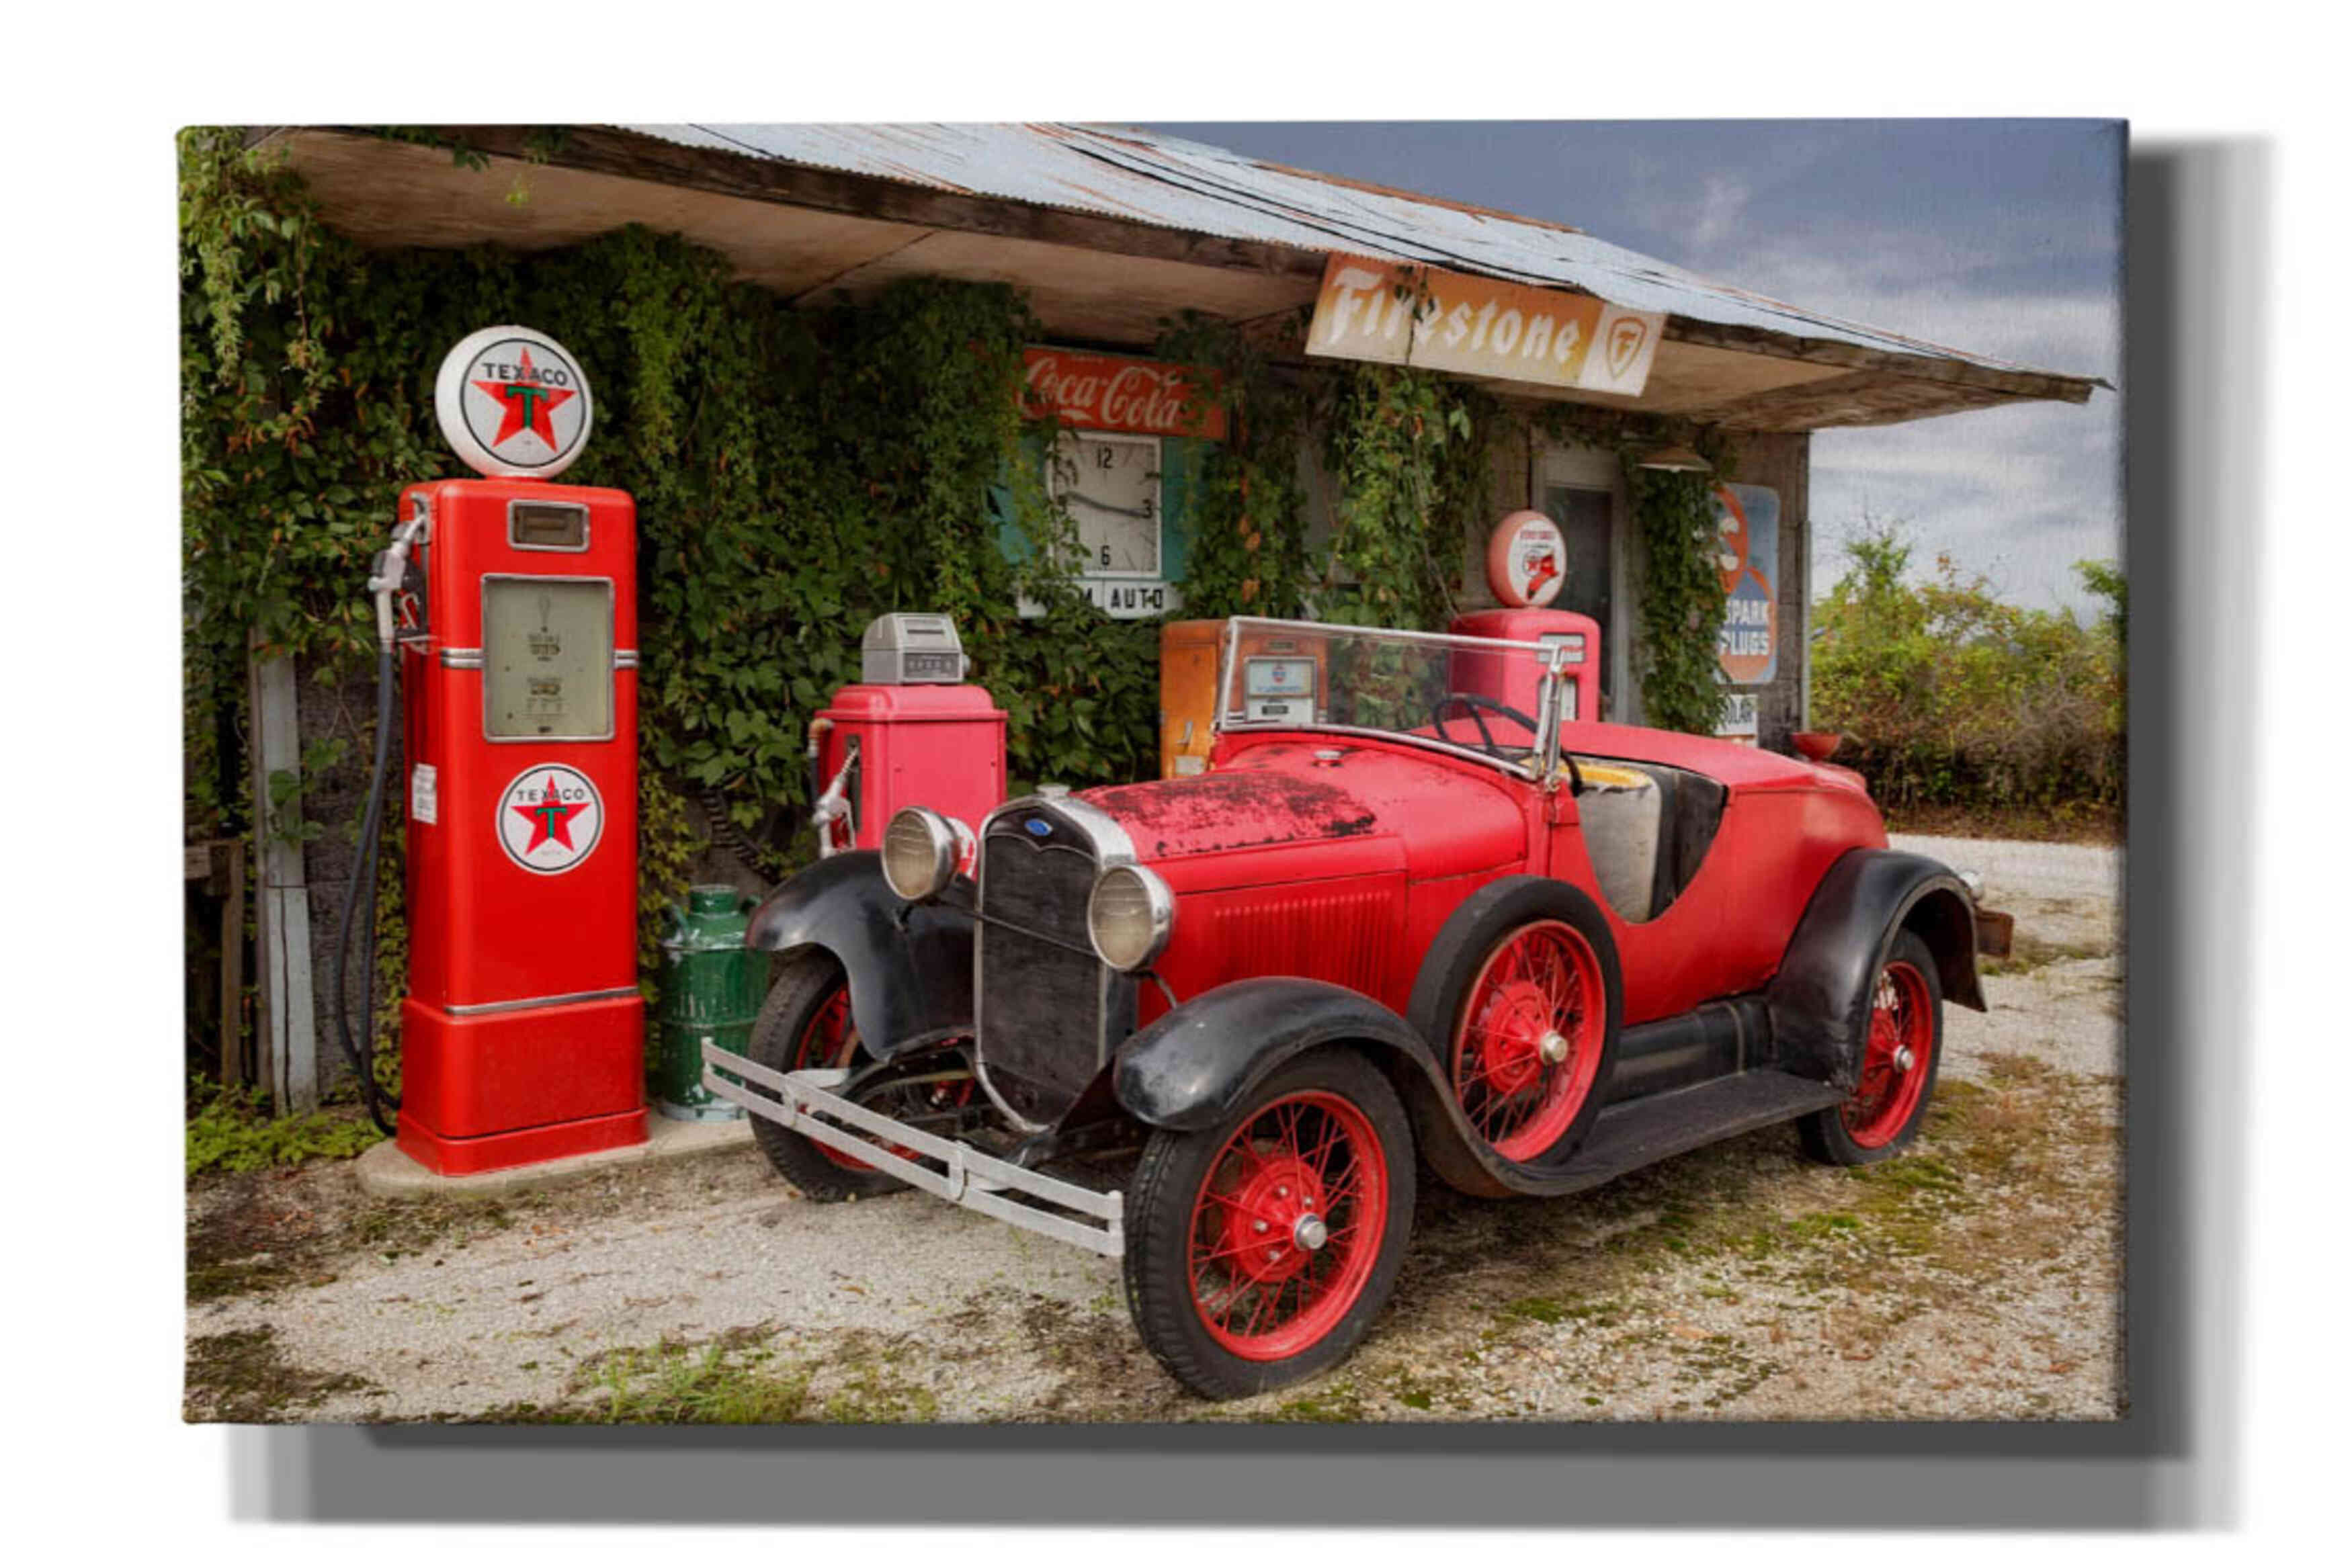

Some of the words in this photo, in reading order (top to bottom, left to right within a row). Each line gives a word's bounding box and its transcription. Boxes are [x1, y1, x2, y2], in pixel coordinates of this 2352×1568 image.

[1327, 266, 1581, 364] Firestone
[481, 362, 568, 386] TEXACO
[1097, 447, 1114, 470] 12
[1142, 498, 1153, 519] 3
[1100, 545, 1111, 566] 6
[1110, 588, 1164, 609] AUTO
[516, 788, 585, 801] TEXACO
